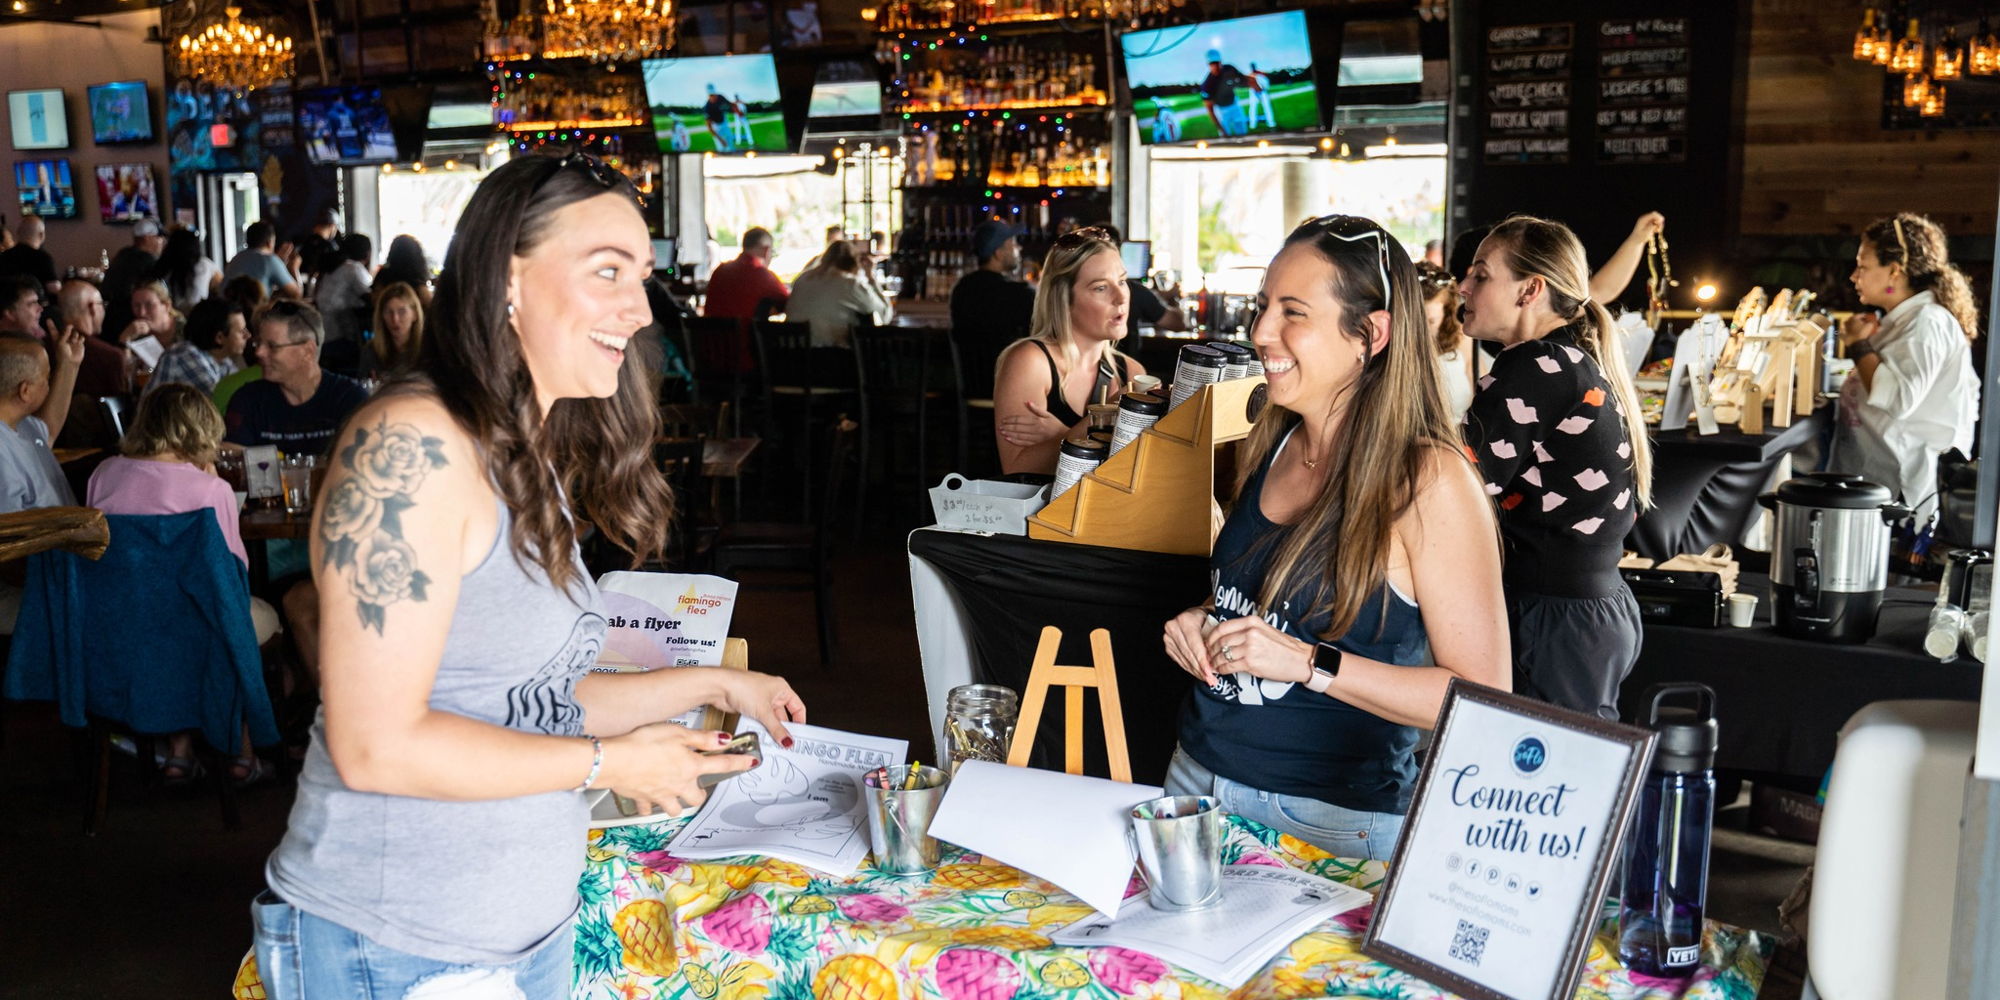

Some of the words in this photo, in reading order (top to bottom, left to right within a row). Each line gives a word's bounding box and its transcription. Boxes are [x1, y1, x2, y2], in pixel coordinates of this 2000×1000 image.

[677, 595, 721, 608] flamingo
[686, 605, 707, 615] flea
[608, 616, 626, 628] ab
[630, 618, 640, 628] a
[644, 617, 681, 631] flyer
[666, 636, 698, 645] Follow
[701, 639, 716, 648] us!
[845, 748, 885, 767] FLEA
[1442, 764, 1578, 817] Connect
[1466, 818, 1531, 853] with
[1538, 826, 1586, 860] us!
[1262, 872, 1339, 893] SEARCH
